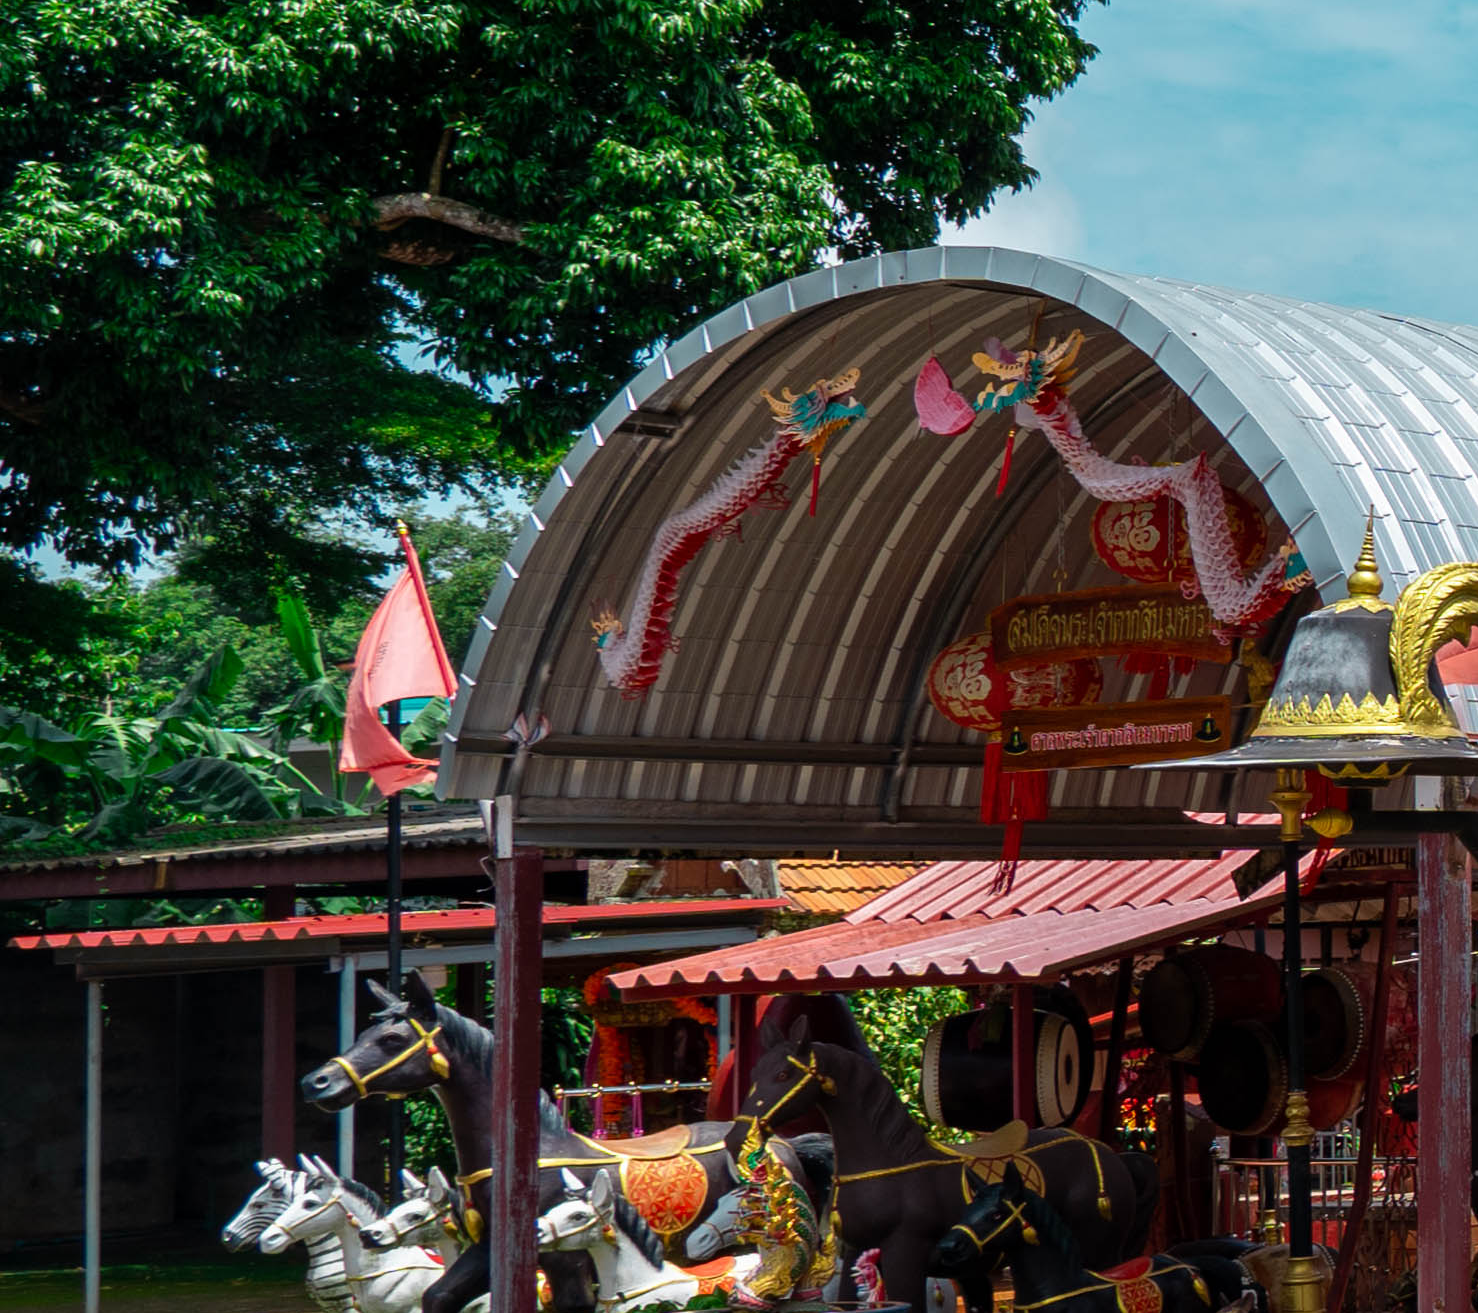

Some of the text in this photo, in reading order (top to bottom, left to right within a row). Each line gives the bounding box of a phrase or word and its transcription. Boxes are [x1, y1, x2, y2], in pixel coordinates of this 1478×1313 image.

[1008, 600, 1219, 652] สมเด็จพระเจ้าตากสินมหาร
